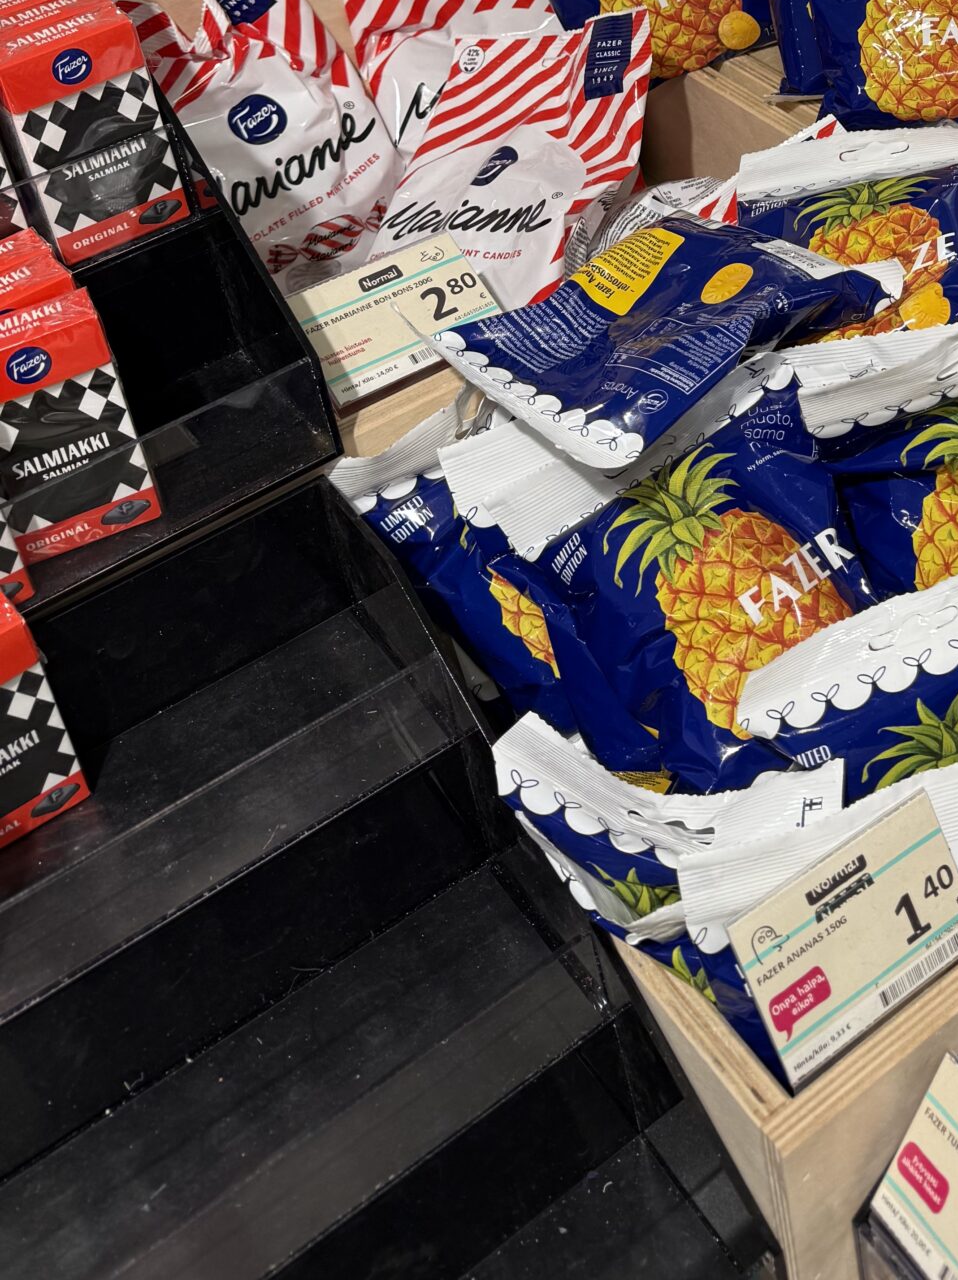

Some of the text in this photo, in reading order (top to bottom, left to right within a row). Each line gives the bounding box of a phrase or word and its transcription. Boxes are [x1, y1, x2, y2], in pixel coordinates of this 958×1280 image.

[6, 12, 96, 51] SALMIAKKI
[597, 39, 622, 48] FAZER
[55, 54, 88, 81] Fazer
[596, 49, 621, 58] CLASSIC
[593, 65, 618, 75] SINCE
[234, 102, 277, 133] Fazer
[62, 135, 147, 181] SALMIAKKI
[88, 161, 130, 182] SALMIAK
[384, 196, 554, 243] Marianne
[73, 221, 130, 250] ORIGINAL
[482, 249, 522, 261] CANDIES
[362, 269, 398, 289] Normal
[304, 277, 434, 335] FAZER MARIANNE BON BONS 200G
[10, 353, 46, 381] Fazer
[744, 426, 785, 441] sama
[13, 431, 110, 480] SALMIAKKI
[26, 523, 91, 552] ORIGINAL
[391, 505, 435, 544] EDITION
[551, 533, 581, 574] LIMITED
[560, 545, 588, 586] EDITION
[737, 528, 856, 626] FAZER
[757, 915, 848, 987] FAZER ANANAS 150G
[771, 973, 825, 1017] Onpa halpa,
